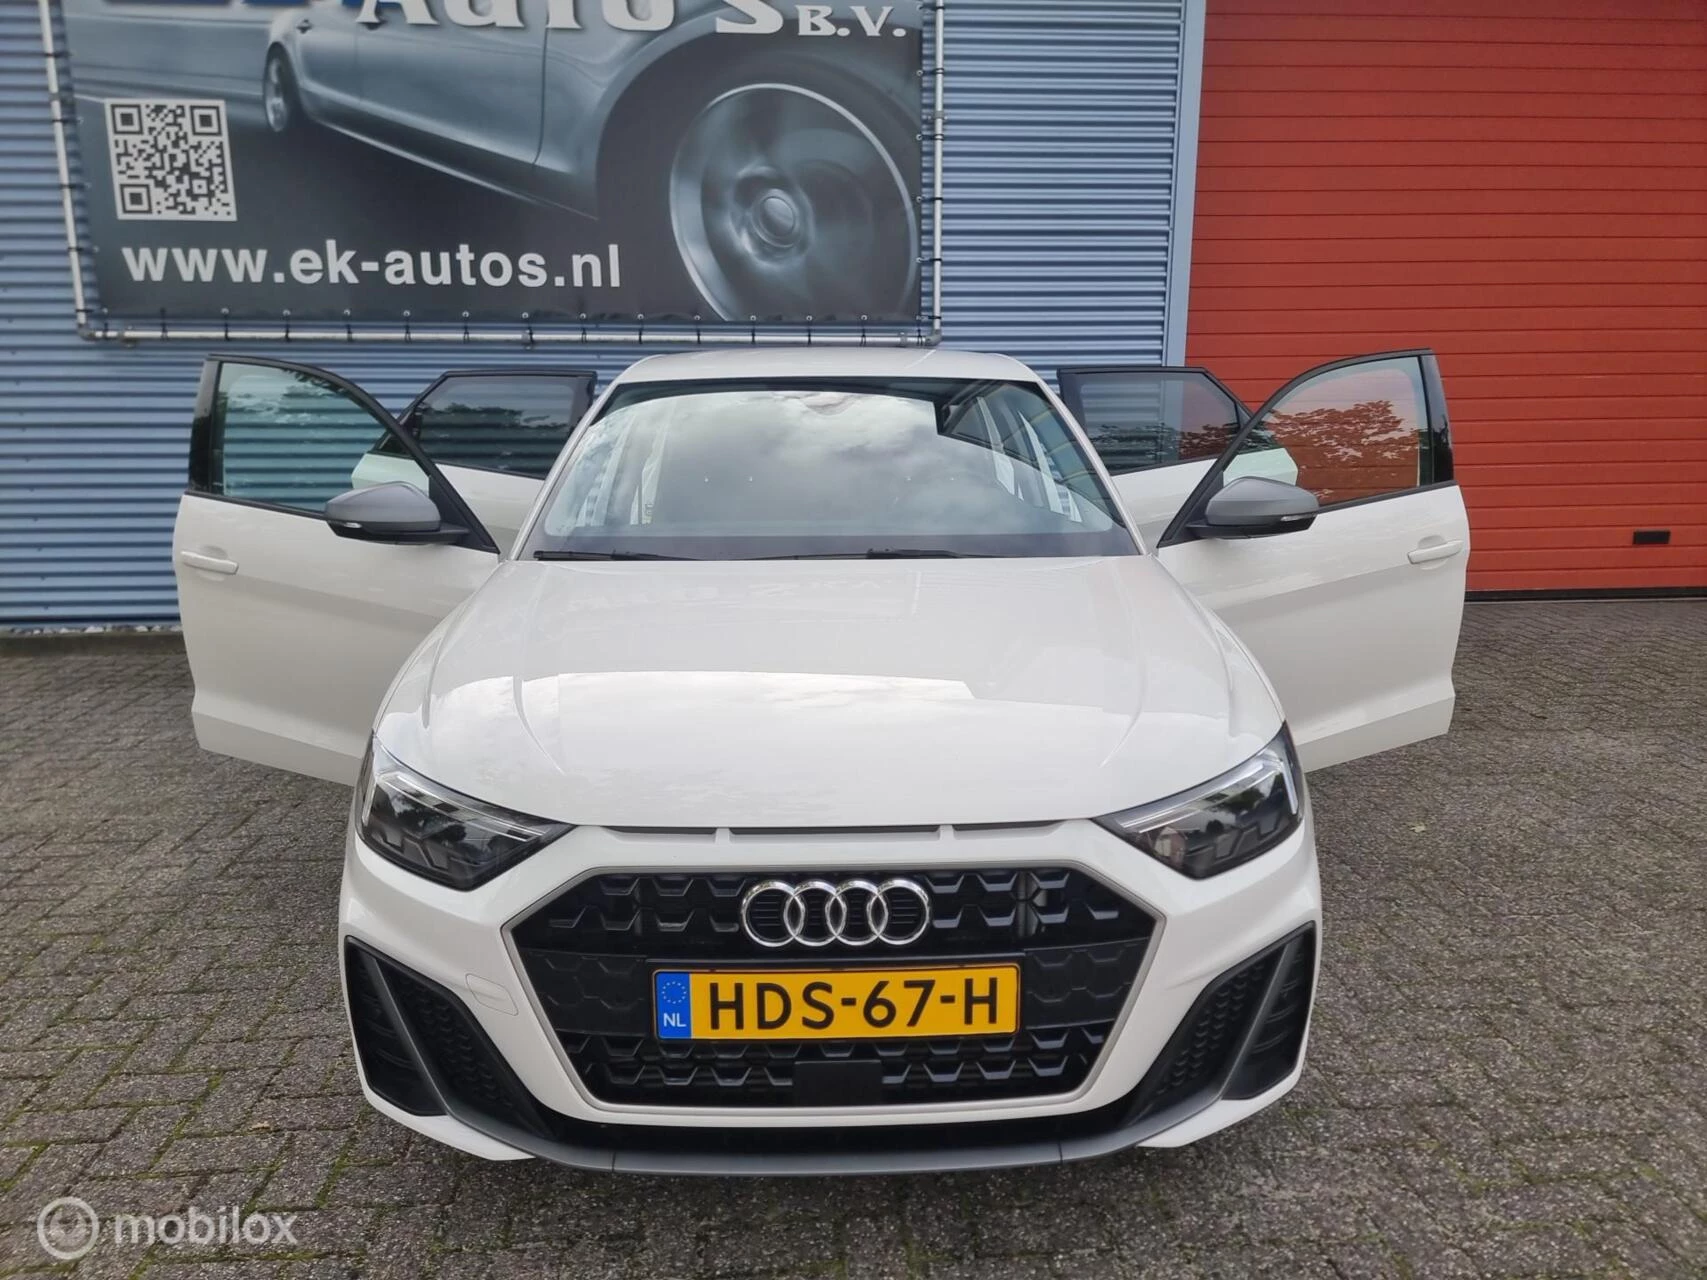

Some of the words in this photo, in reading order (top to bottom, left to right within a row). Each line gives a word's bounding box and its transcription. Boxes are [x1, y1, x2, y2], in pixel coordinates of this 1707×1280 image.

[796, 5, 906, 37] B.V.
[122, 240, 621, 287] www.ek-autos.nl
[662, 1014, 687, 1028] NL
[709, 977, 998, 1030] HDS-67-H
